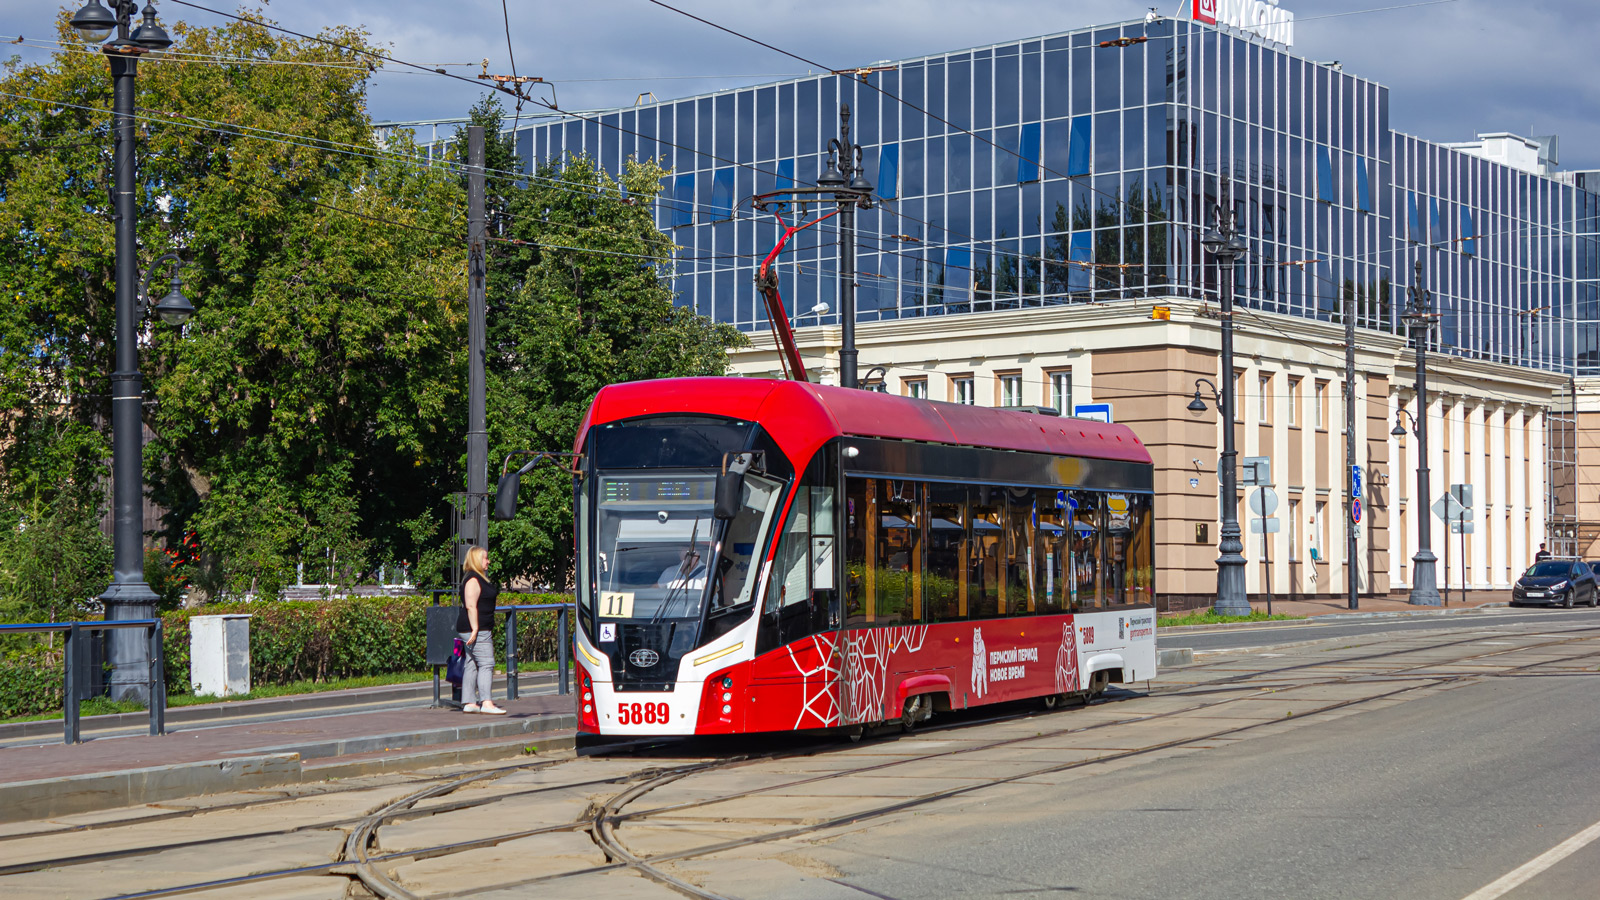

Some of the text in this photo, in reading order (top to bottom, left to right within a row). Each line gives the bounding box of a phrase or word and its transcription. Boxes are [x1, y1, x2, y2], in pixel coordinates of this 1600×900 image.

[605, 594, 624, 616] 11
[990, 646, 1038, 665] ПЕРМСКИЙ ПЕРИОД
[990, 665, 1025, 682] НОВОЕ ВРЕМЯ
[618, 702, 670, 726] 5889
